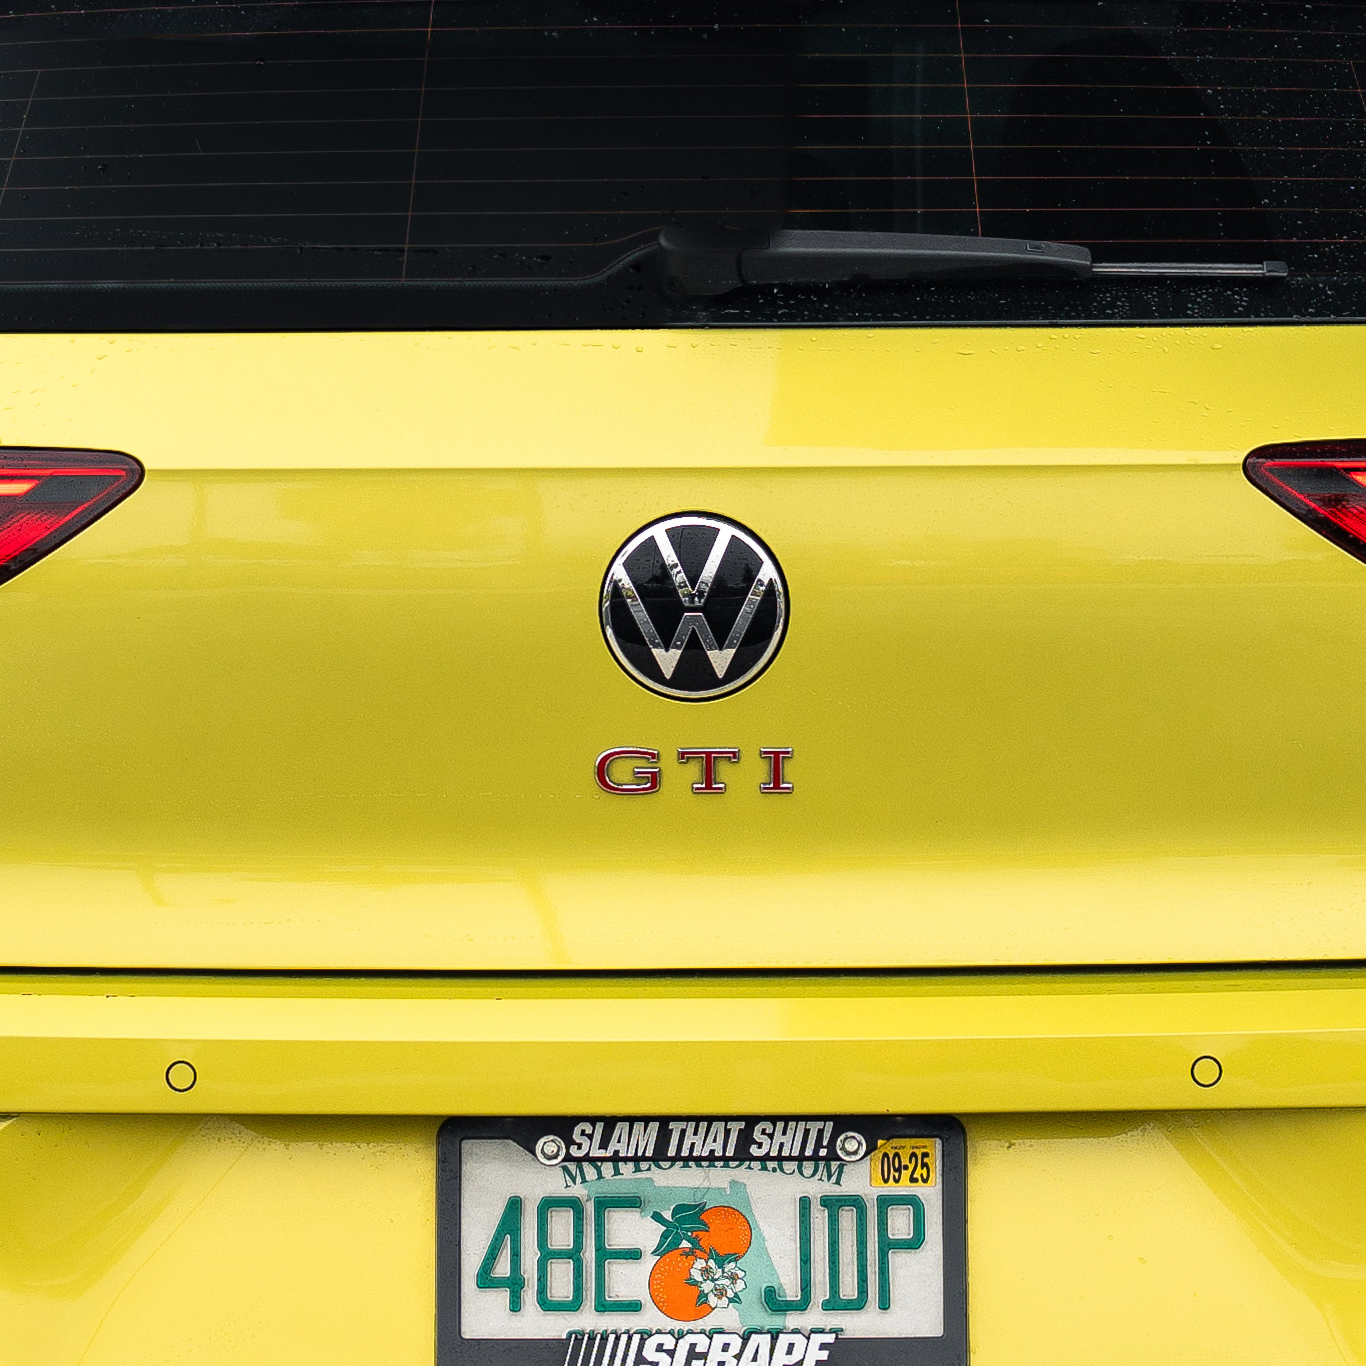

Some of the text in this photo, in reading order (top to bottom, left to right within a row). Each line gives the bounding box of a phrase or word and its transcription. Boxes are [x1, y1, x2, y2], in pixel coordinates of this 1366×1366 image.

[608, 518, 780, 680] VW
[594, 746, 794, 794] GTI
[569, 1121, 834, 1157] SLAM THAT SHIT!
[560, 1160, 847, 1188] MYF.COM
[880, 1151, 931, 1184] 09-25
[476, 1195, 926, 1313] 48E JDP
